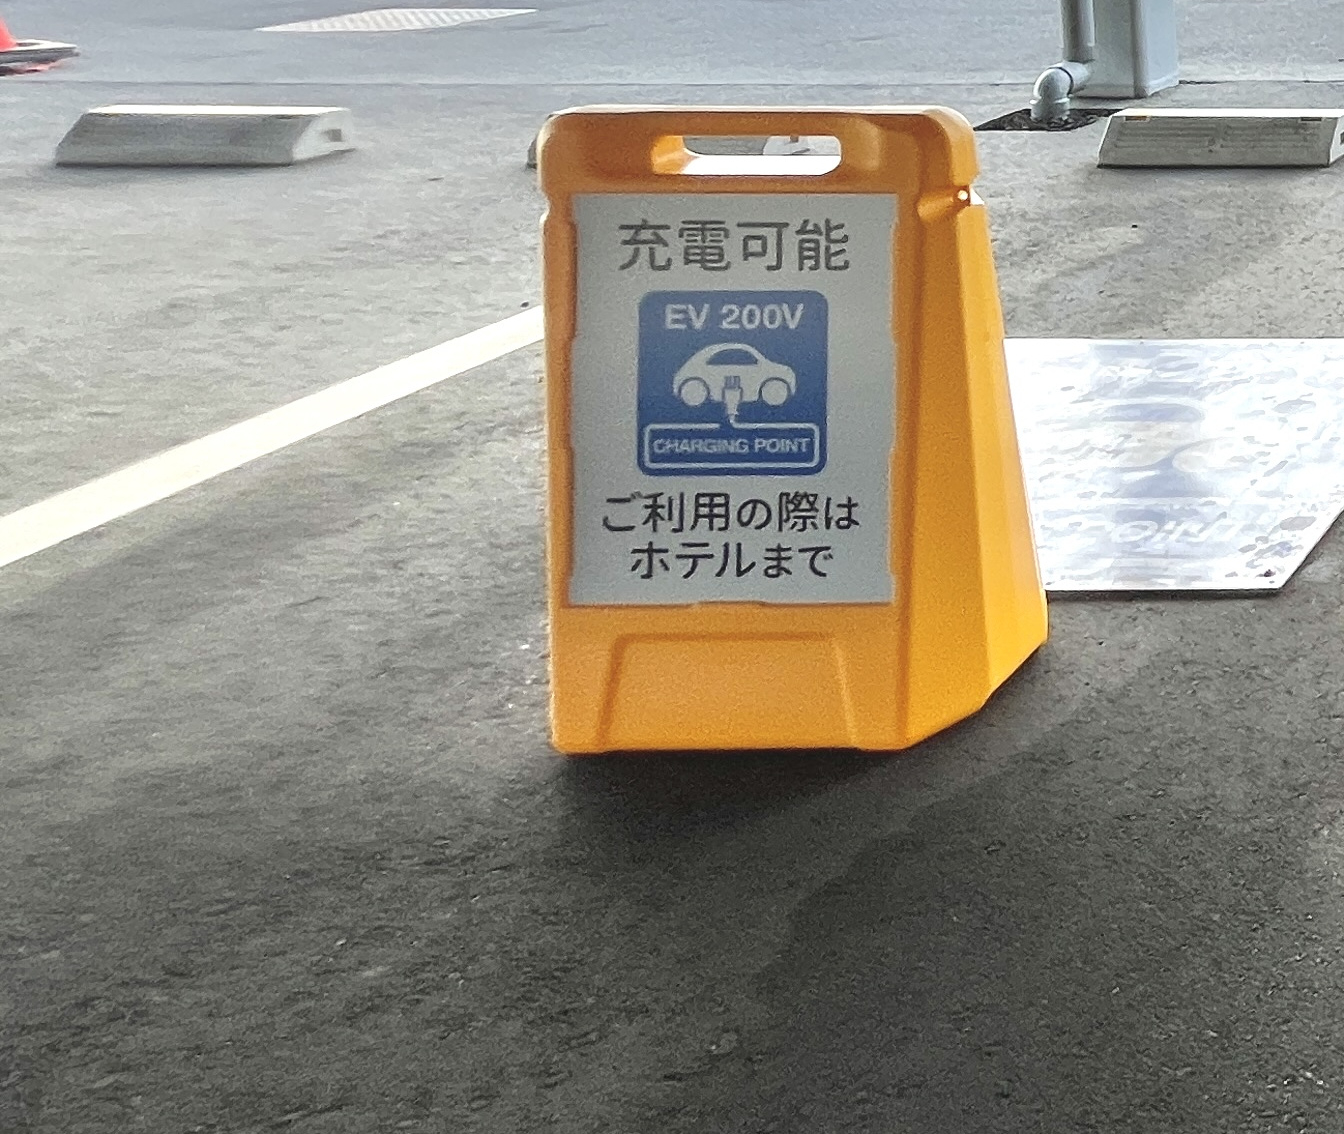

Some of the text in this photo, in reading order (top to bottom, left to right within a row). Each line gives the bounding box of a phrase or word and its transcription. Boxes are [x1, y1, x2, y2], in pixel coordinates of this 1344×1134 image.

[618, 218, 850, 272] 充電可能
[664, 303, 805, 331] EV 200V
[652, 437, 811, 454] CHARGING POINT
[601, 491, 860, 533] ご利用の際は
[630, 541, 834, 580] ホテルまで
